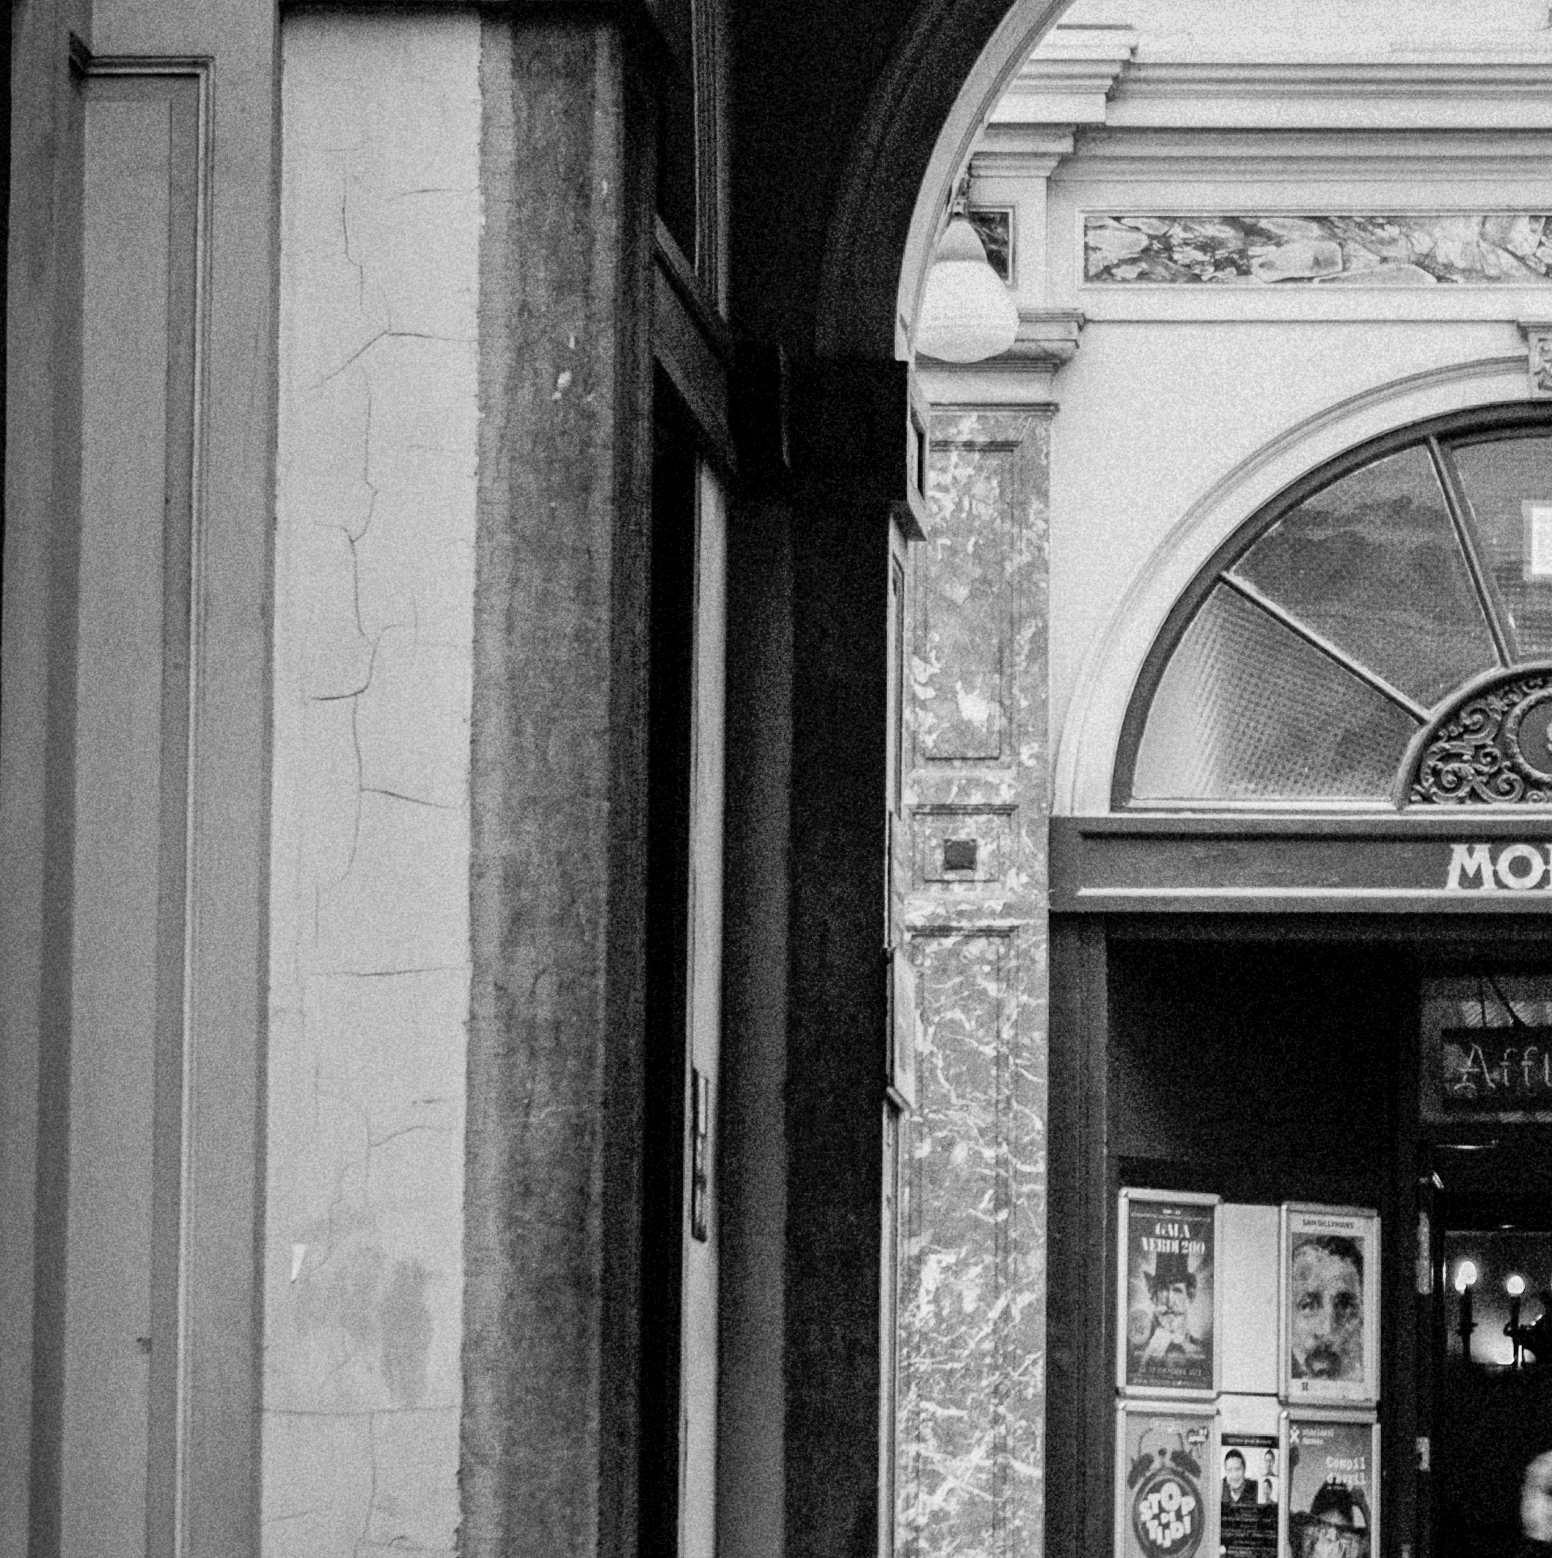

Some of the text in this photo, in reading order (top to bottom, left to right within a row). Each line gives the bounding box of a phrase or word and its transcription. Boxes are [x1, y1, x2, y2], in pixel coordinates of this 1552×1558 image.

[1181, 1240, 1206, 1255] 200
[1139, 1481, 1196, 1521] STOP
[1146, 1514, 1191, 1549] TIJD!
